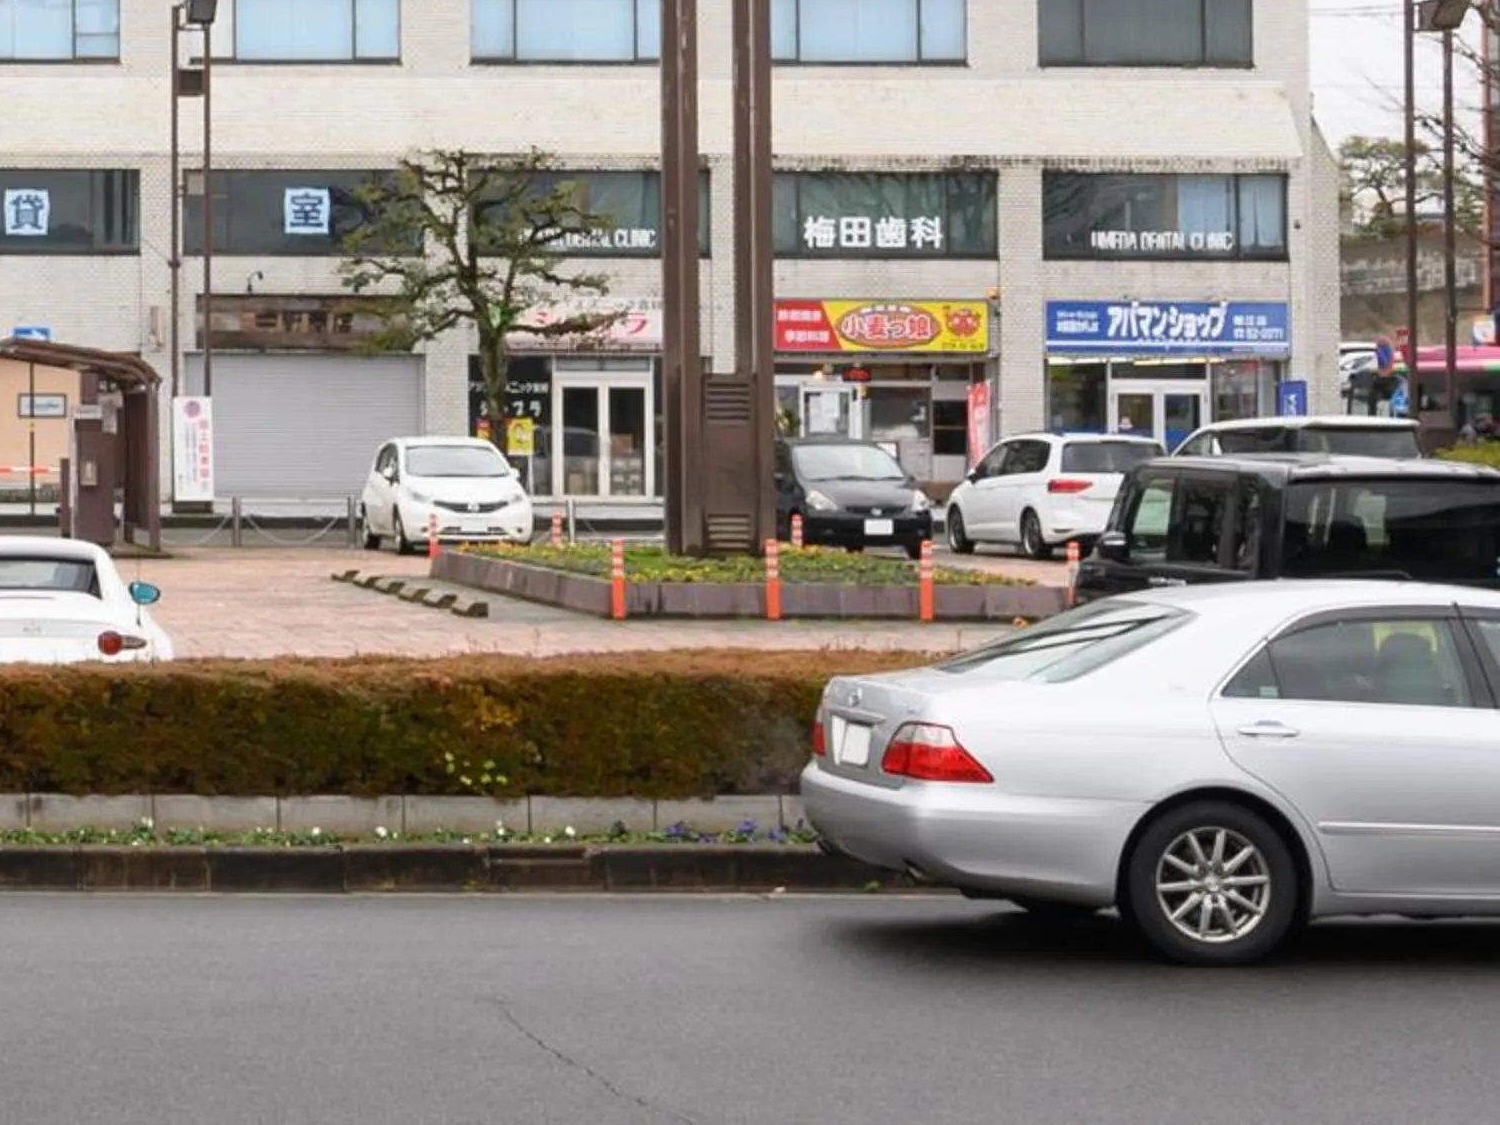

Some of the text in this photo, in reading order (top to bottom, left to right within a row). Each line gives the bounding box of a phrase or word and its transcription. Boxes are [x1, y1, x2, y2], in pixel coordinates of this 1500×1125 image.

[9, 192, 325, 231] 貸 室
[803, 215, 944, 249] 梅田歯科
[1107, 301, 1228, 338] アパマンショップ
